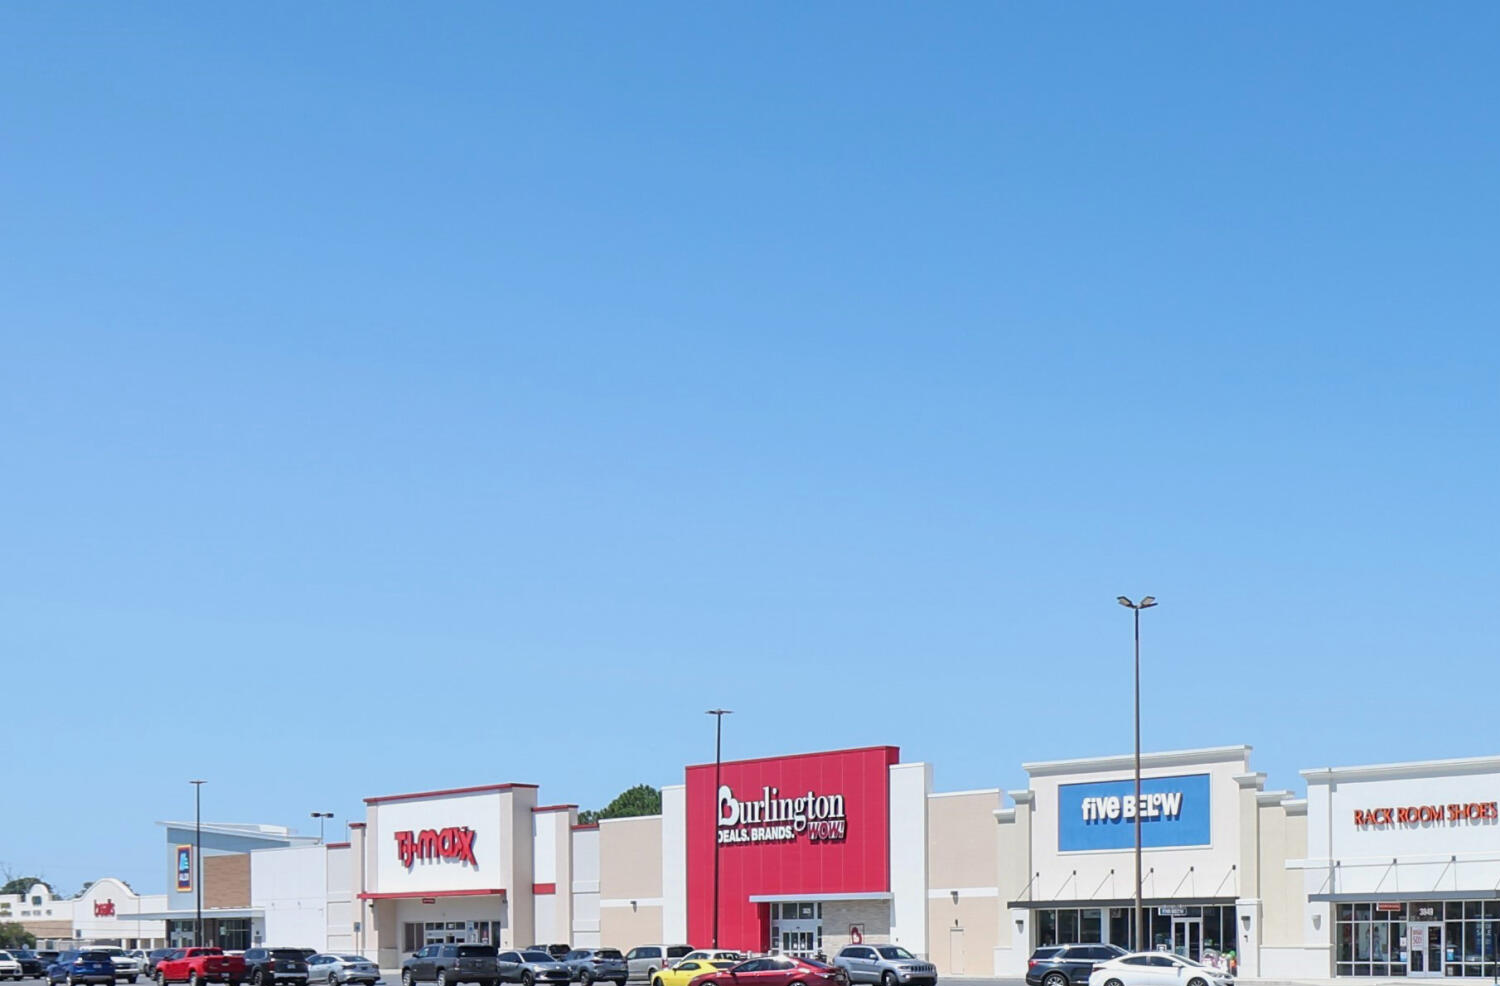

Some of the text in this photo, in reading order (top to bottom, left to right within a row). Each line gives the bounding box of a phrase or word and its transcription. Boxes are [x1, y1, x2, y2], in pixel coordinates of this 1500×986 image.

[718, 785, 845, 831] Burlington
[1123, 792, 1181, 818] BELOW
[1354, 802, 1498, 825] RACK ROOM SHOES
[751, 826, 794, 840] BRANDS.
[808, 820, 845, 839] WOW!
